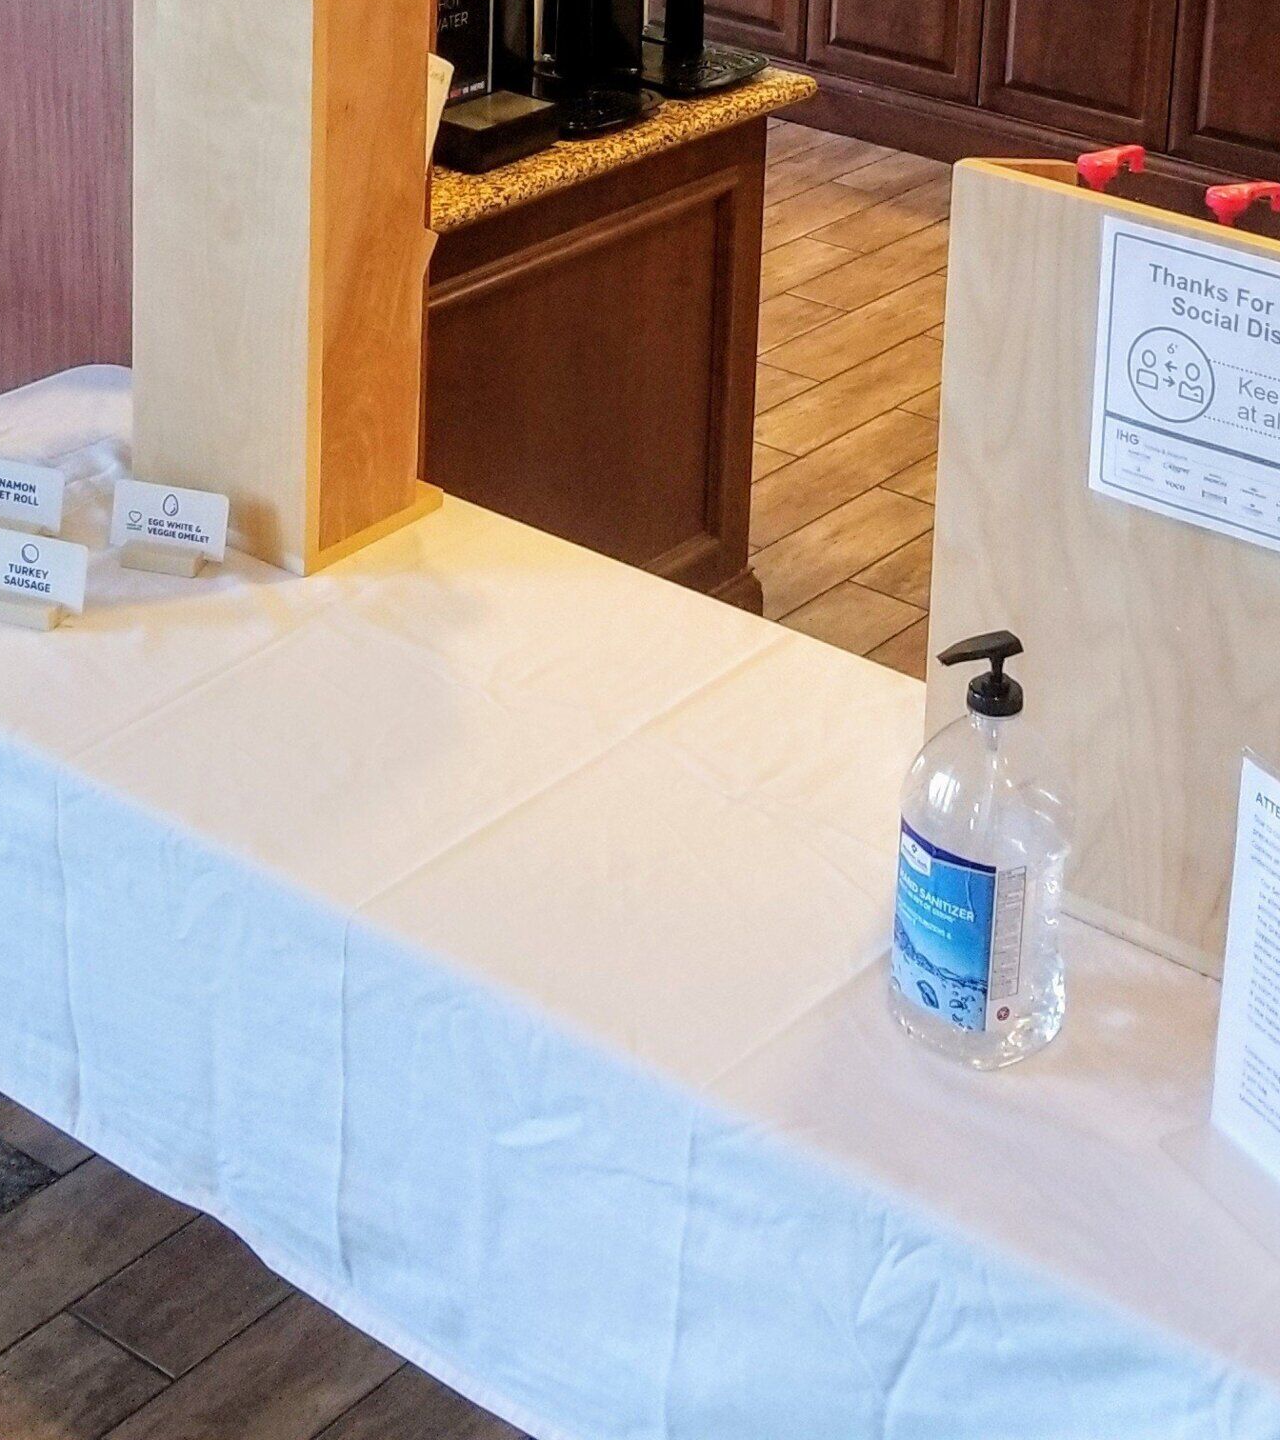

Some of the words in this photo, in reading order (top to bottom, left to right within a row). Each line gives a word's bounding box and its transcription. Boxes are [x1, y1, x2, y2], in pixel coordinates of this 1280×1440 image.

[437, 11, 469, 33] ATER
[1148, 263, 1228, 302] Thanks
[1236, 288, 1274, 315] For
[1171, 296, 1238, 333] Social
[1237, 405, 1257, 424] at
[1116, 428, 1140, 446] IHG
[13, 489, 39, 506] ROLL
[148, 517, 165, 528] EGG
[166, 520, 194, 533] WHITE
[147, 527, 176, 539] VEGGIE
[177, 531, 210, 544] OMELET
[8, 563, 49, 580] TURKEY
[4, 574, 51, 593] SAUSAGE
[920, 889, 975, 923] SANITIZER
